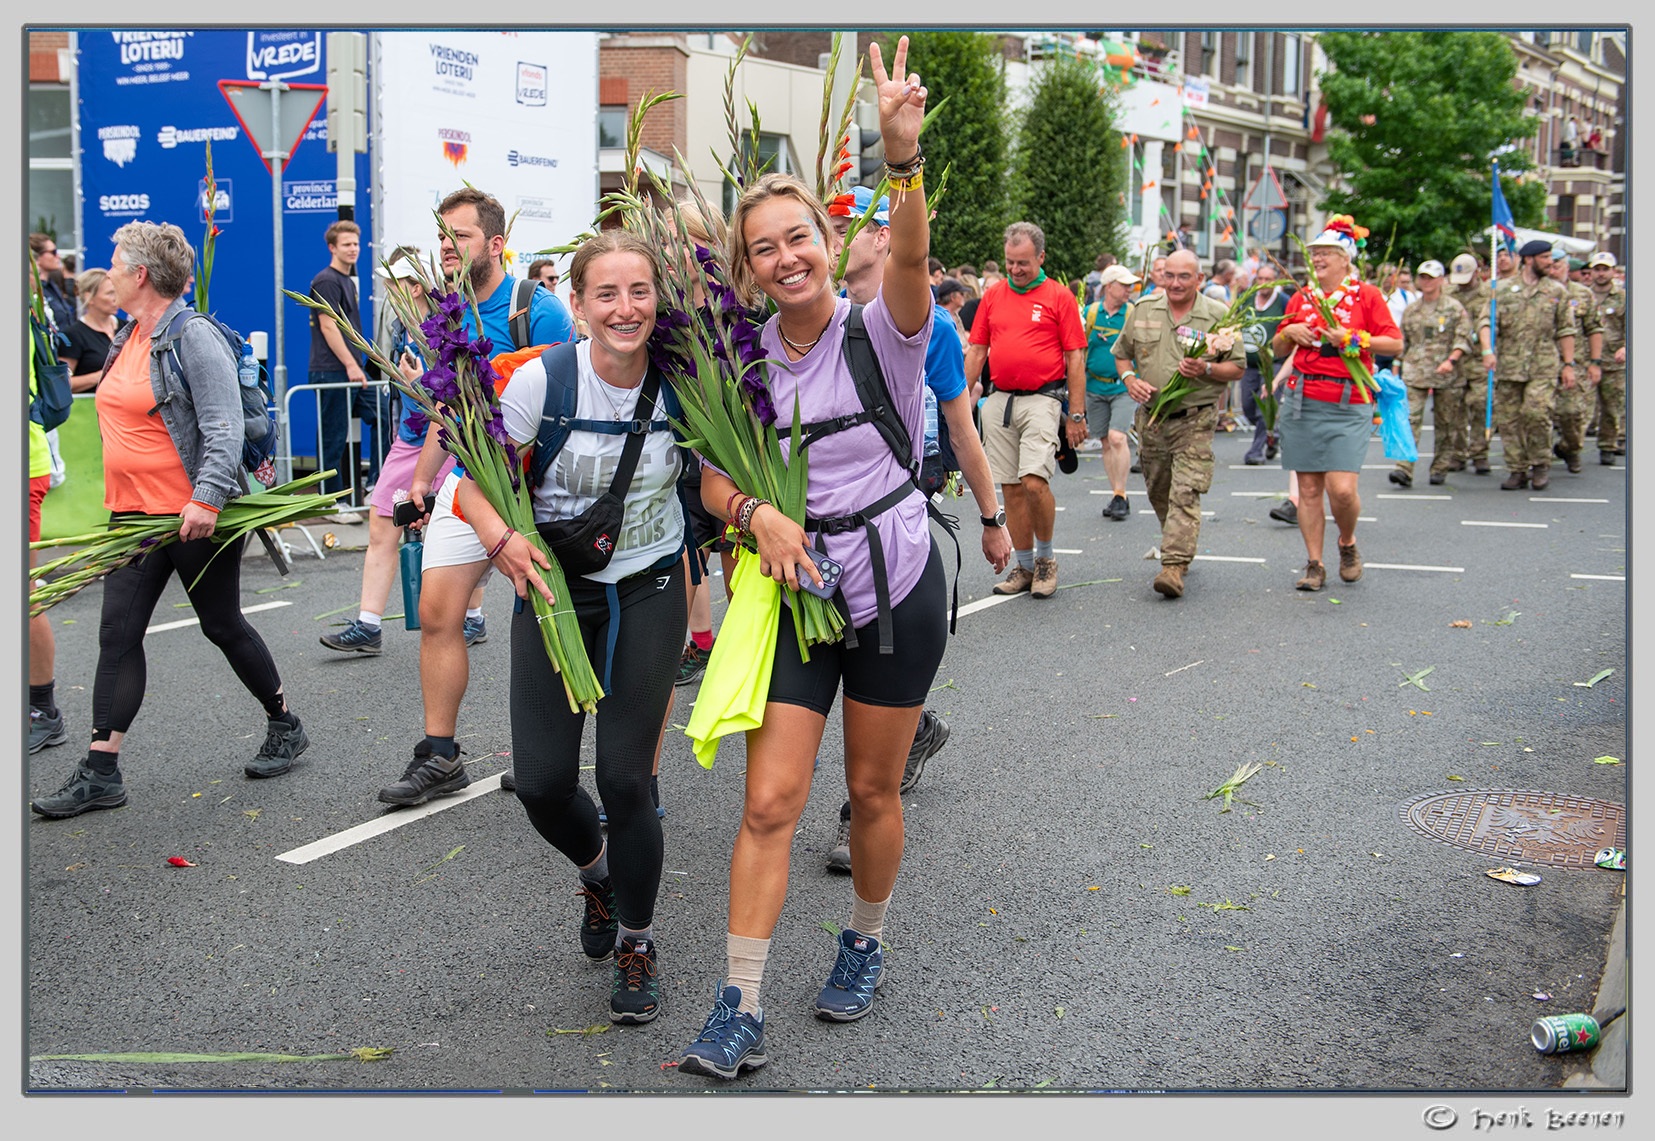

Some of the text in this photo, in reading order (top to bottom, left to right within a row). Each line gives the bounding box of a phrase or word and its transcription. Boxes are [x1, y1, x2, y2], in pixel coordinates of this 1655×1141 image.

[121, 38, 184, 65] LOTERIJ
[252, 41, 316, 69] VREDE
[429, 43, 479, 66] VRIENDEN
[436, 61, 473, 81] LOTERIJ
[176, 126, 238, 143] BAUERFEIND
[438, 127, 472, 143] PERSKINDOL
[519, 154, 557, 168] BAUERFEIND
[292, 184, 333, 196] provincie
[99, 193, 151, 211] sazas
[286, 196, 338, 210] Gelderlan
